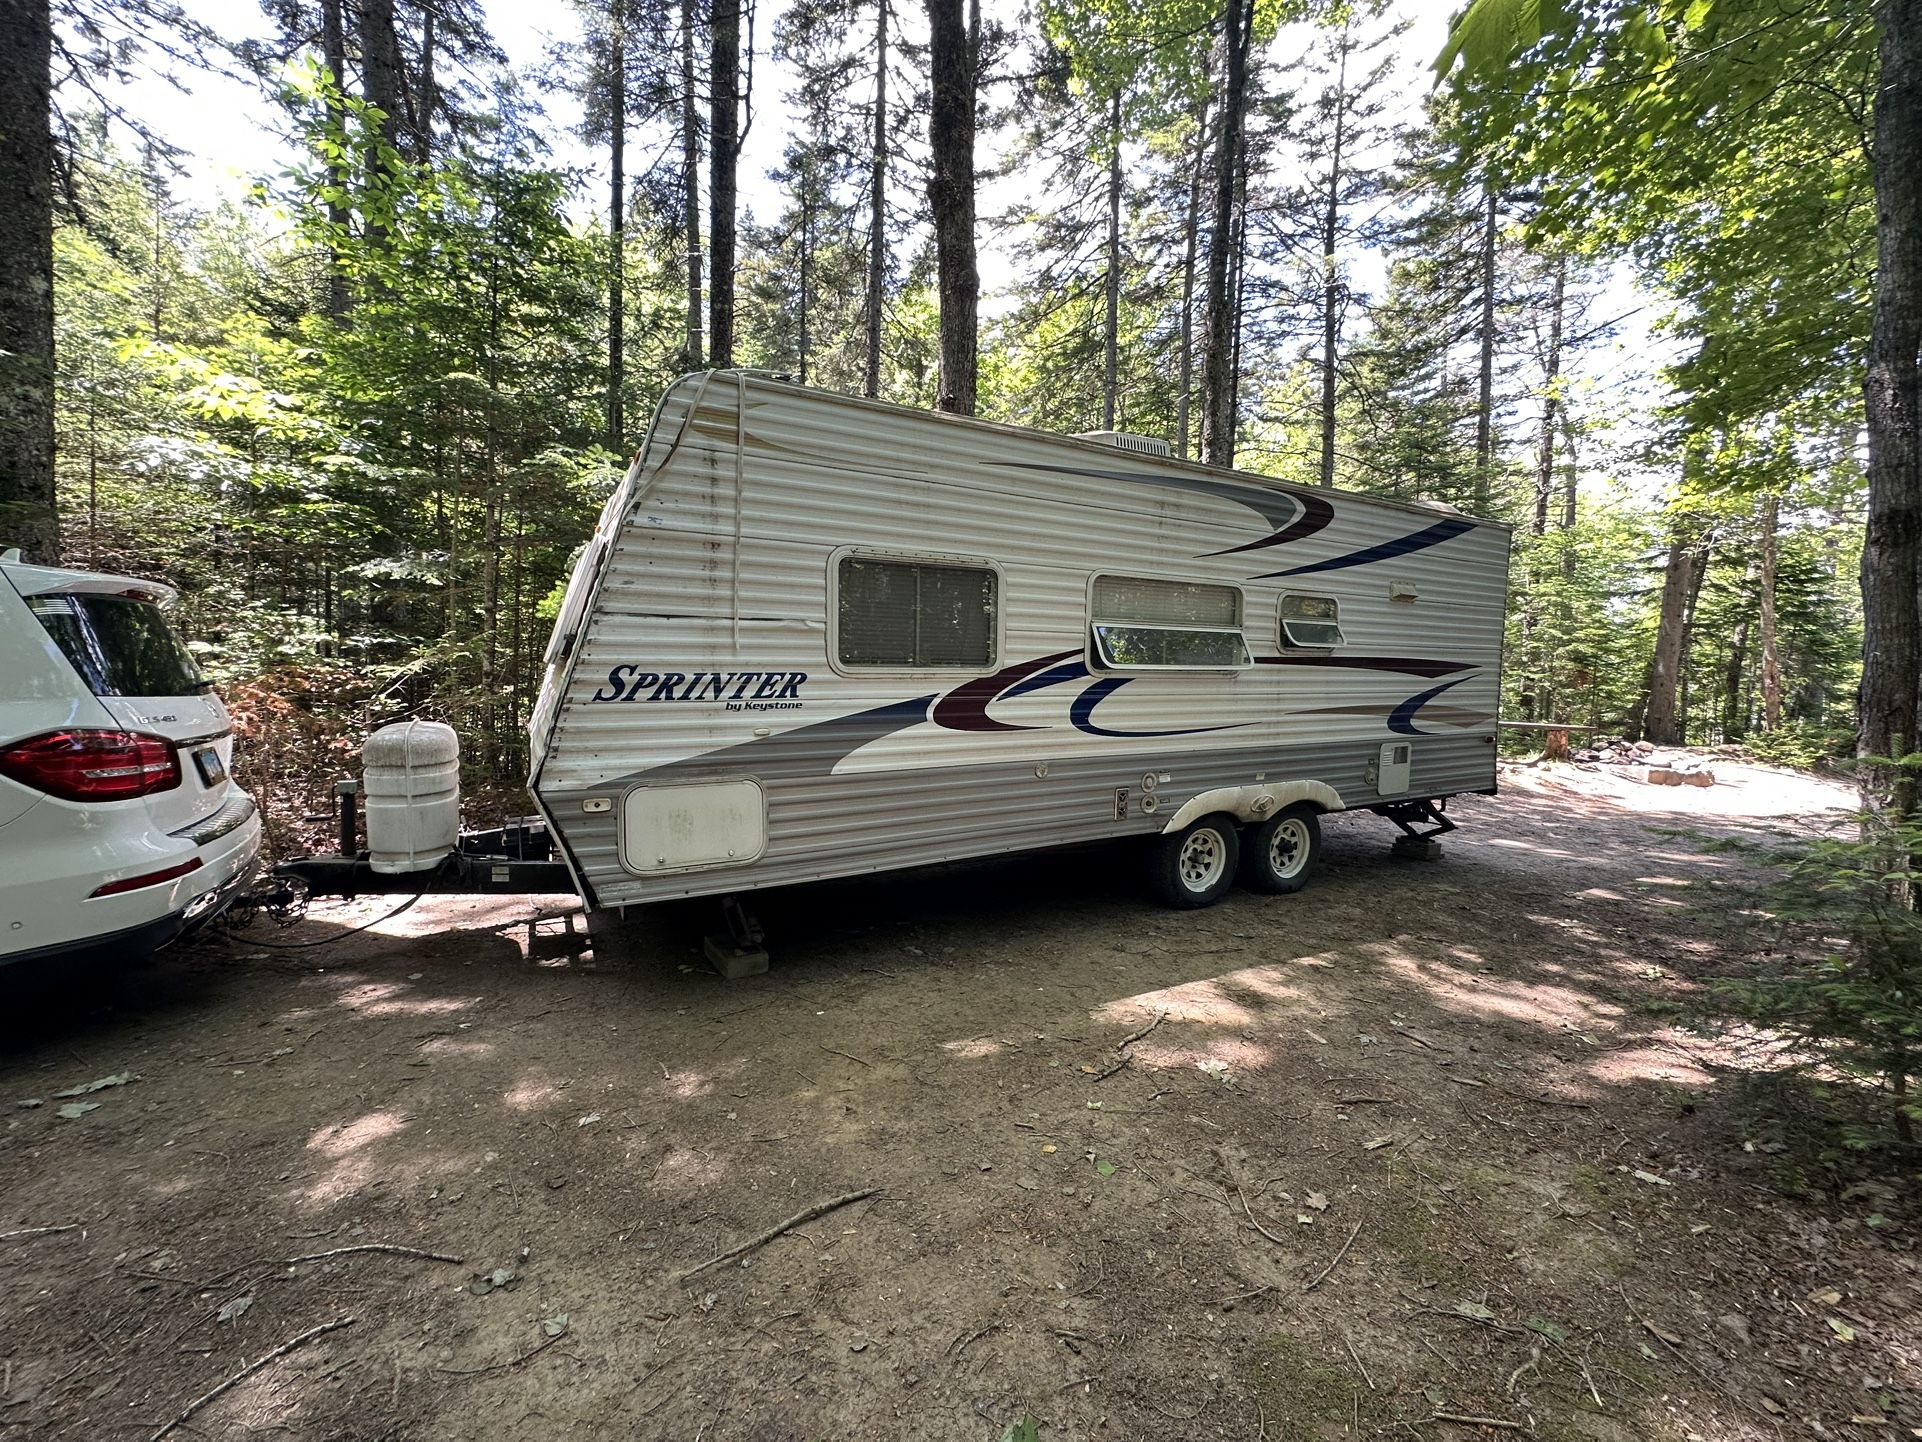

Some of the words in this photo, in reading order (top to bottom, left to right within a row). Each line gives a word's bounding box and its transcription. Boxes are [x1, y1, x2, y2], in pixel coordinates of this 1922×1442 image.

[592, 664, 808, 702] SPRINTER
[725, 702, 742, 712] by
[744, 702, 803, 711] Keystone
